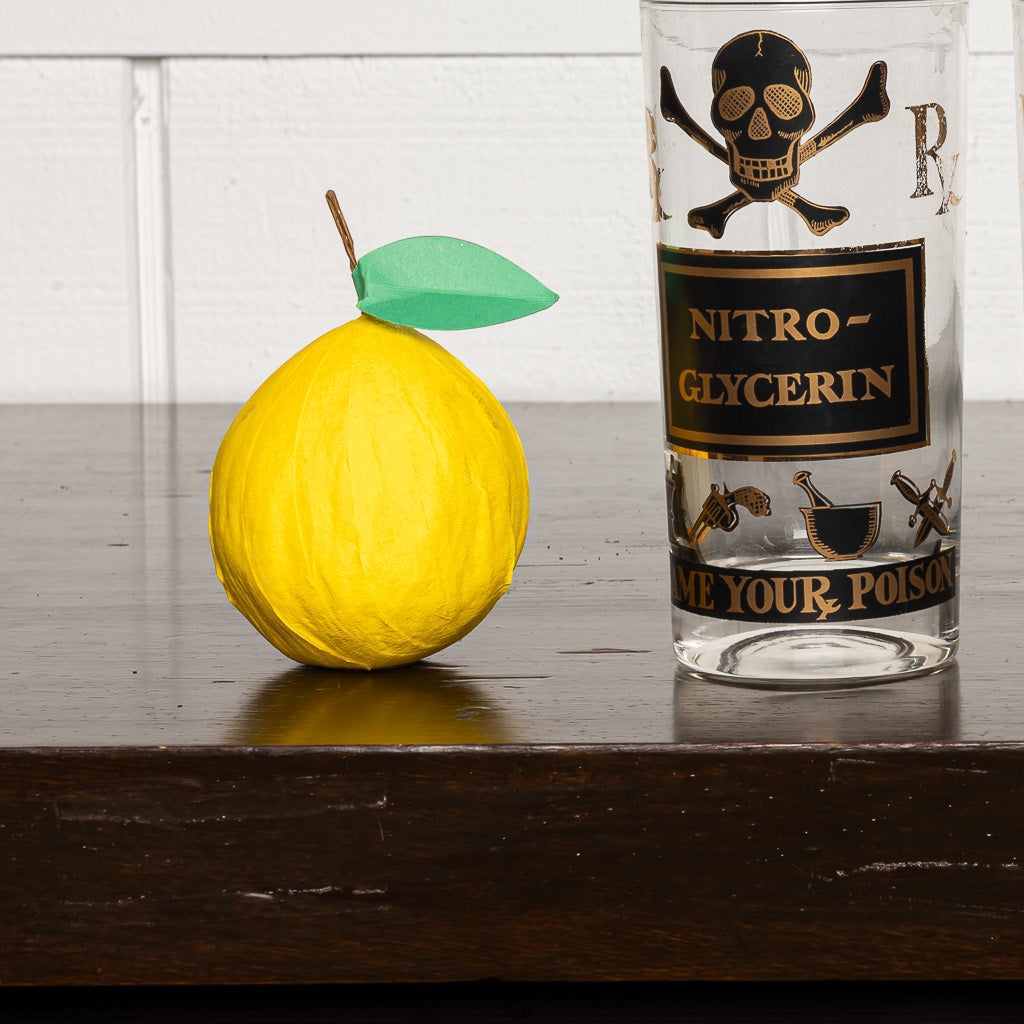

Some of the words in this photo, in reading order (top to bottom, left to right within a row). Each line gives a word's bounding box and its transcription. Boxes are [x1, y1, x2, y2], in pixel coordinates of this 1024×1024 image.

[688, 308, 871, 341] NITRO-
[679, 365, 895, 407] GLYCERIN
[847, 552, 953, 610] POISON
